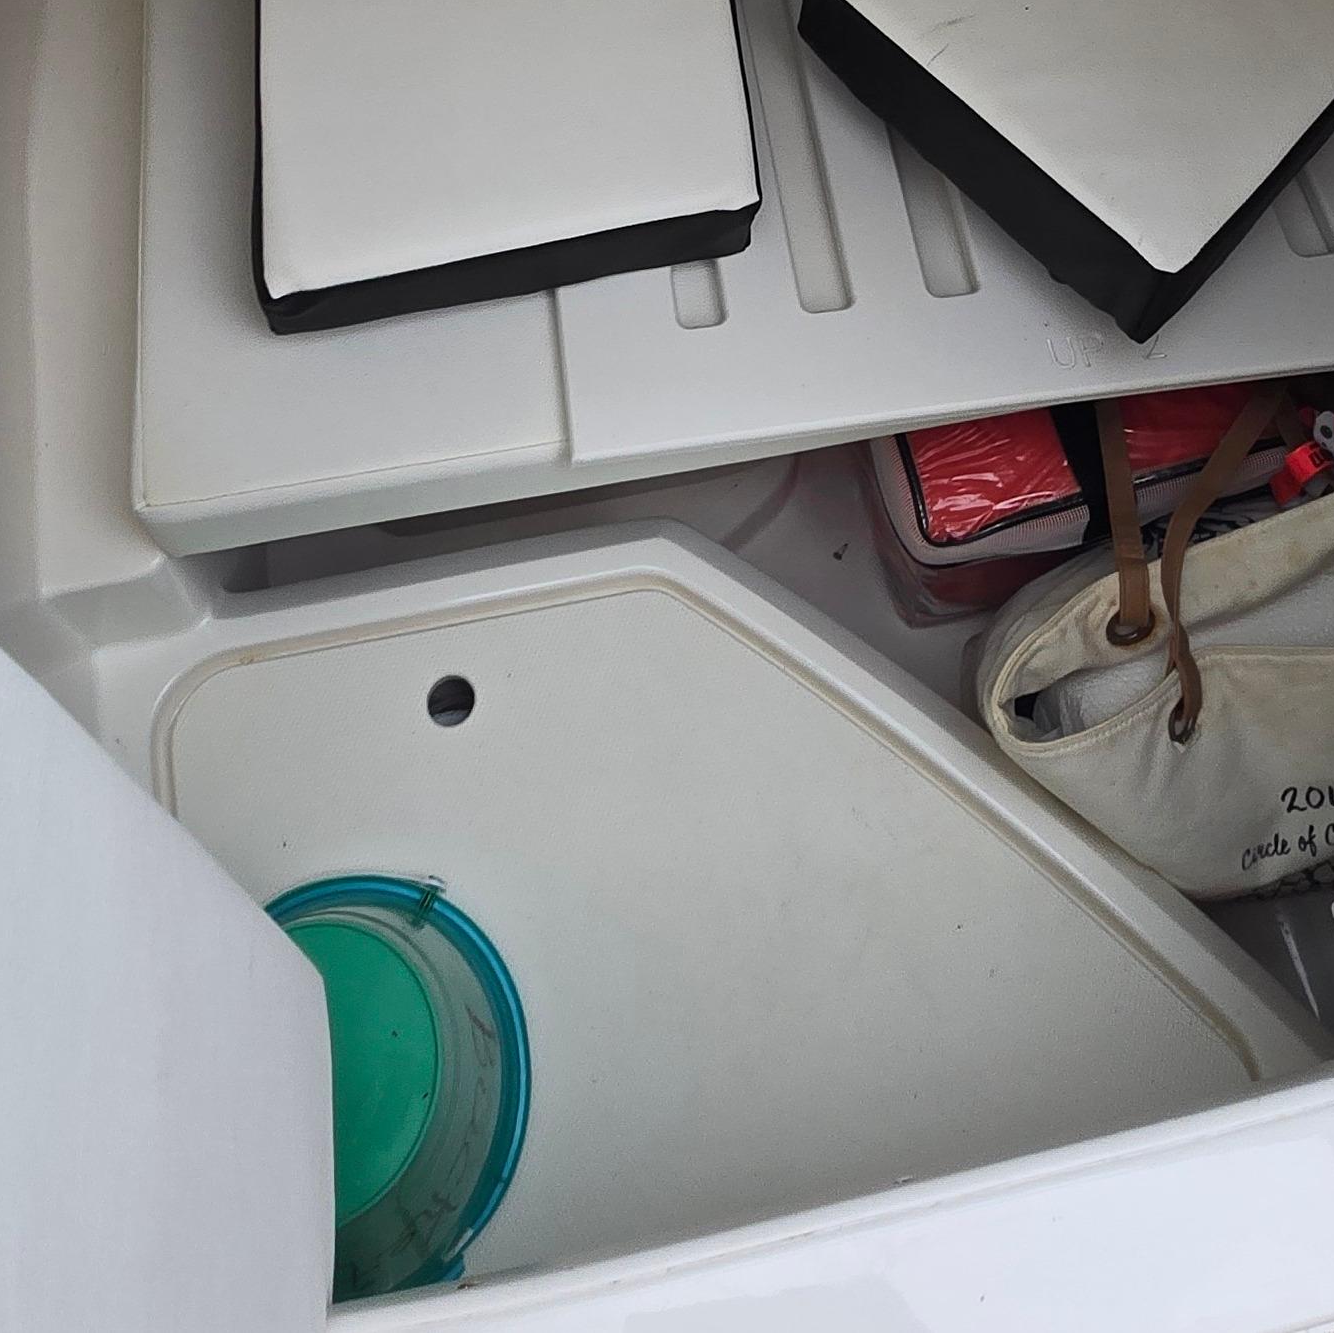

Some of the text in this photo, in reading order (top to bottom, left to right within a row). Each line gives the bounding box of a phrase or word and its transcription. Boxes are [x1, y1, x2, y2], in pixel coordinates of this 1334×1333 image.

[1046, 330, 1105, 369] UP
[1242, 832, 1291, 871] Circle
[1298, 824, 1317, 857] of
